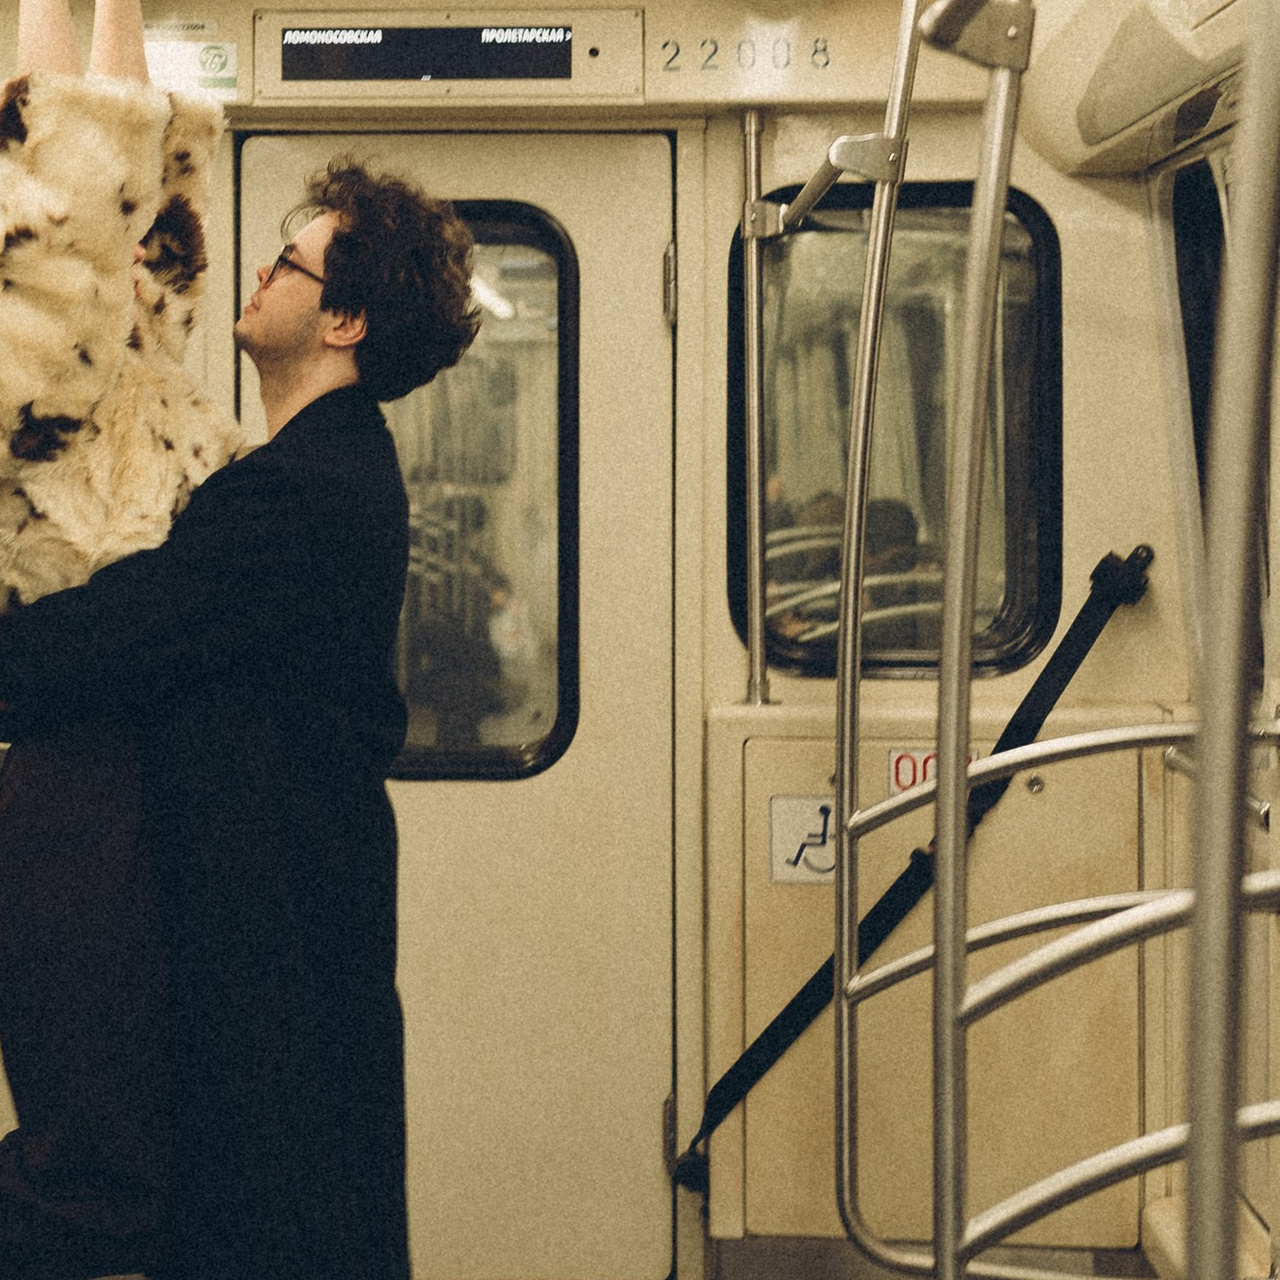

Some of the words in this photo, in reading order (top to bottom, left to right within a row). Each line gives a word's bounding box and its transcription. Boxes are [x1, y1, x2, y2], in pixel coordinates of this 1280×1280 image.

[282, 29, 383, 45] ЛОМОНОСОВСКАЯ
[481, 27, 564, 44] ПРОЛЕТАРСКАЯ
[660, 37, 831, 72] 22008
